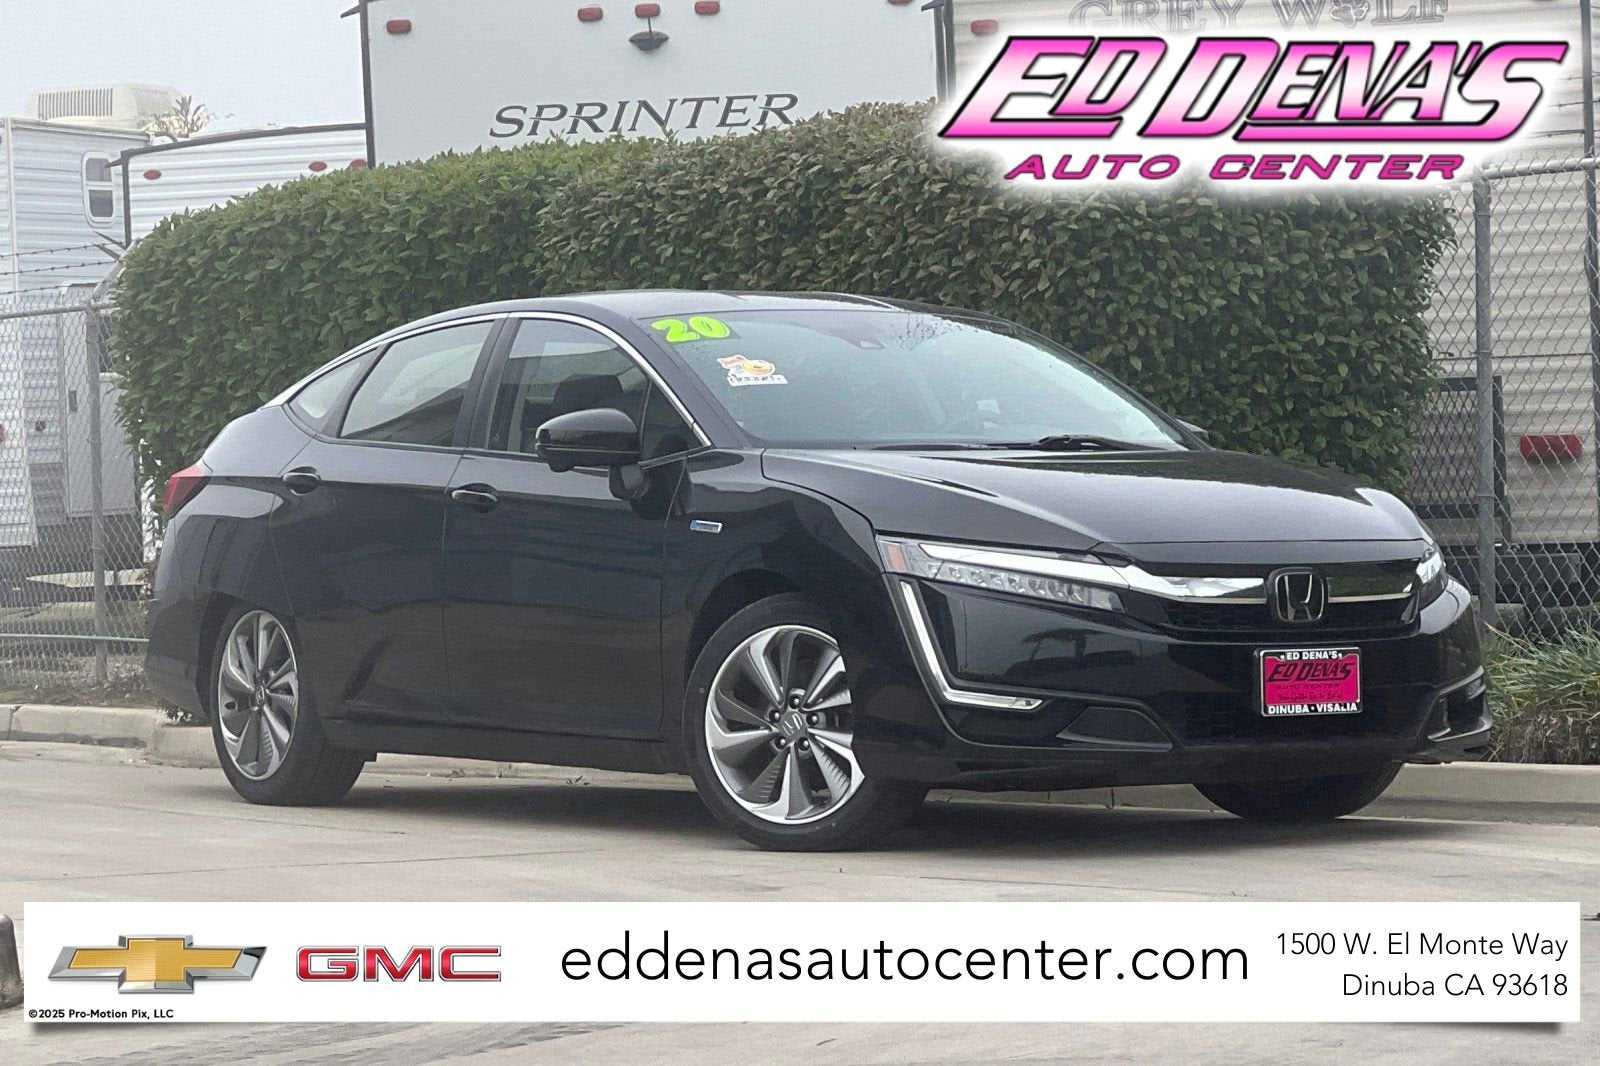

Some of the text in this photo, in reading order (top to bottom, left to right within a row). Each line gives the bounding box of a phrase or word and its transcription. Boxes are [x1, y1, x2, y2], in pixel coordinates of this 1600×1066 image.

[1068, 0, 1243, 33] GREY
[489, 93, 799, 138] SPRINTER
[651, 316, 730, 342] 20
[1286, 651, 1338, 660] ED DENA'S
[1267, 663, 1299, 682] ED
[1268, 702, 1357, 714] DINUBA VISALIA
